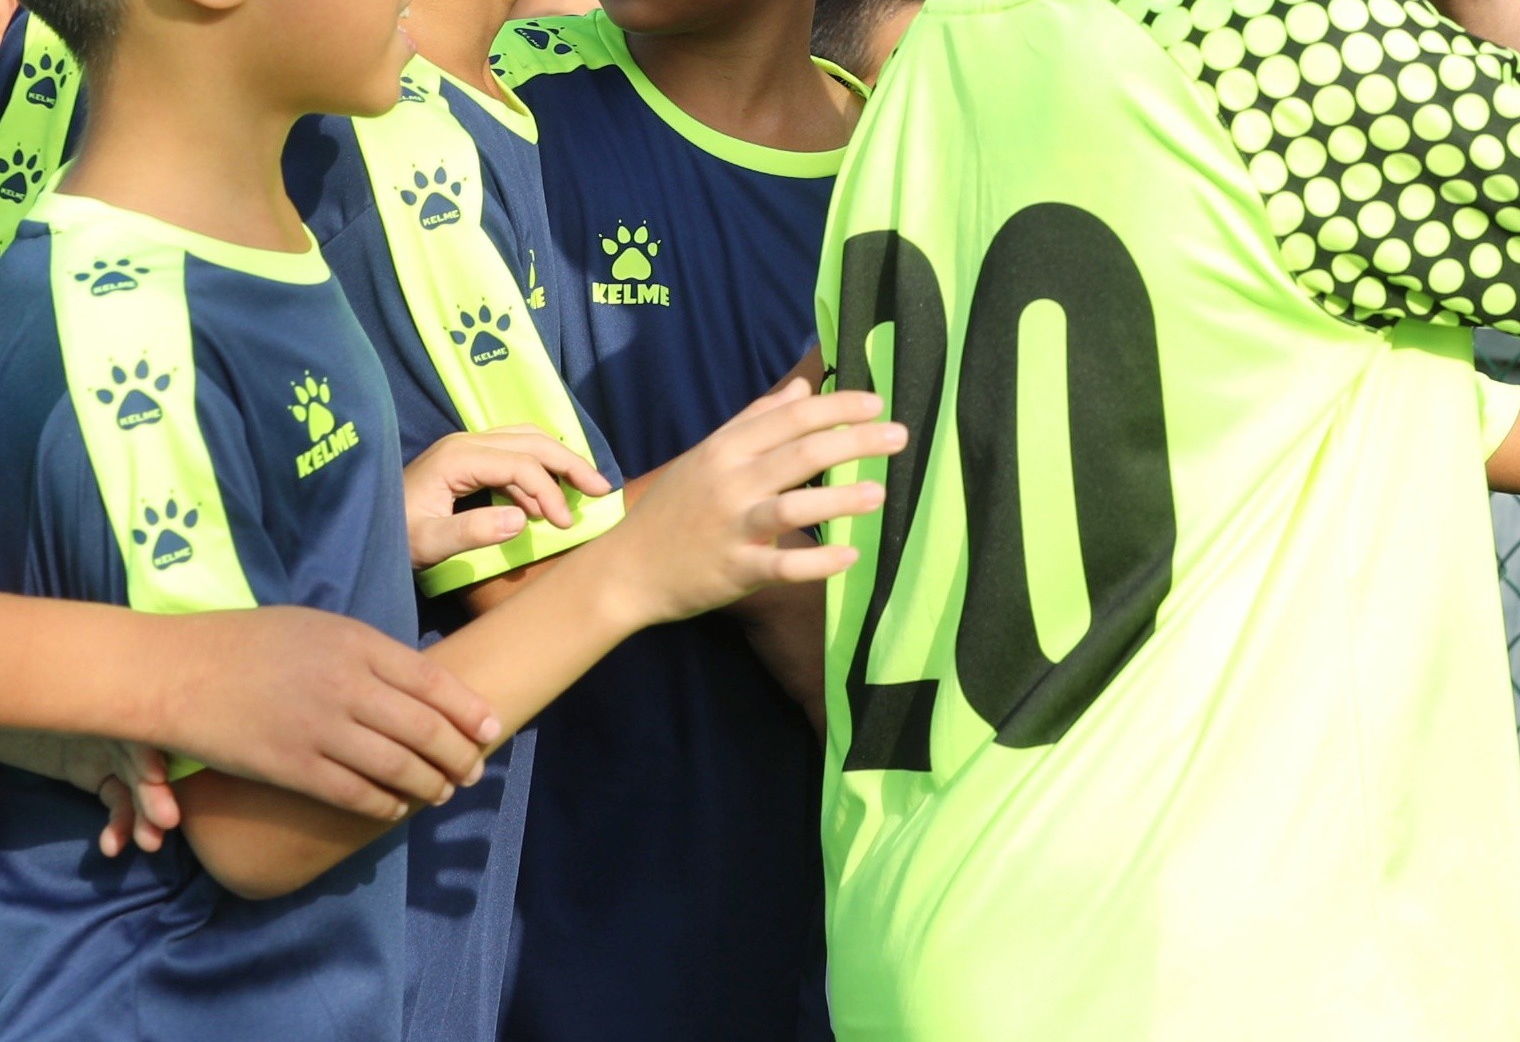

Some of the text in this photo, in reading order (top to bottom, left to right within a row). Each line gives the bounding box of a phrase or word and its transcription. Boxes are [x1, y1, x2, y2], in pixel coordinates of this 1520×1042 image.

[422, 209, 460, 227] KELME
[592, 282, 670, 307] KELME
[473, 347, 508, 363] KELME
[296, 421, 359, 479] KELME
[835, 201, 1177, 773] 20
